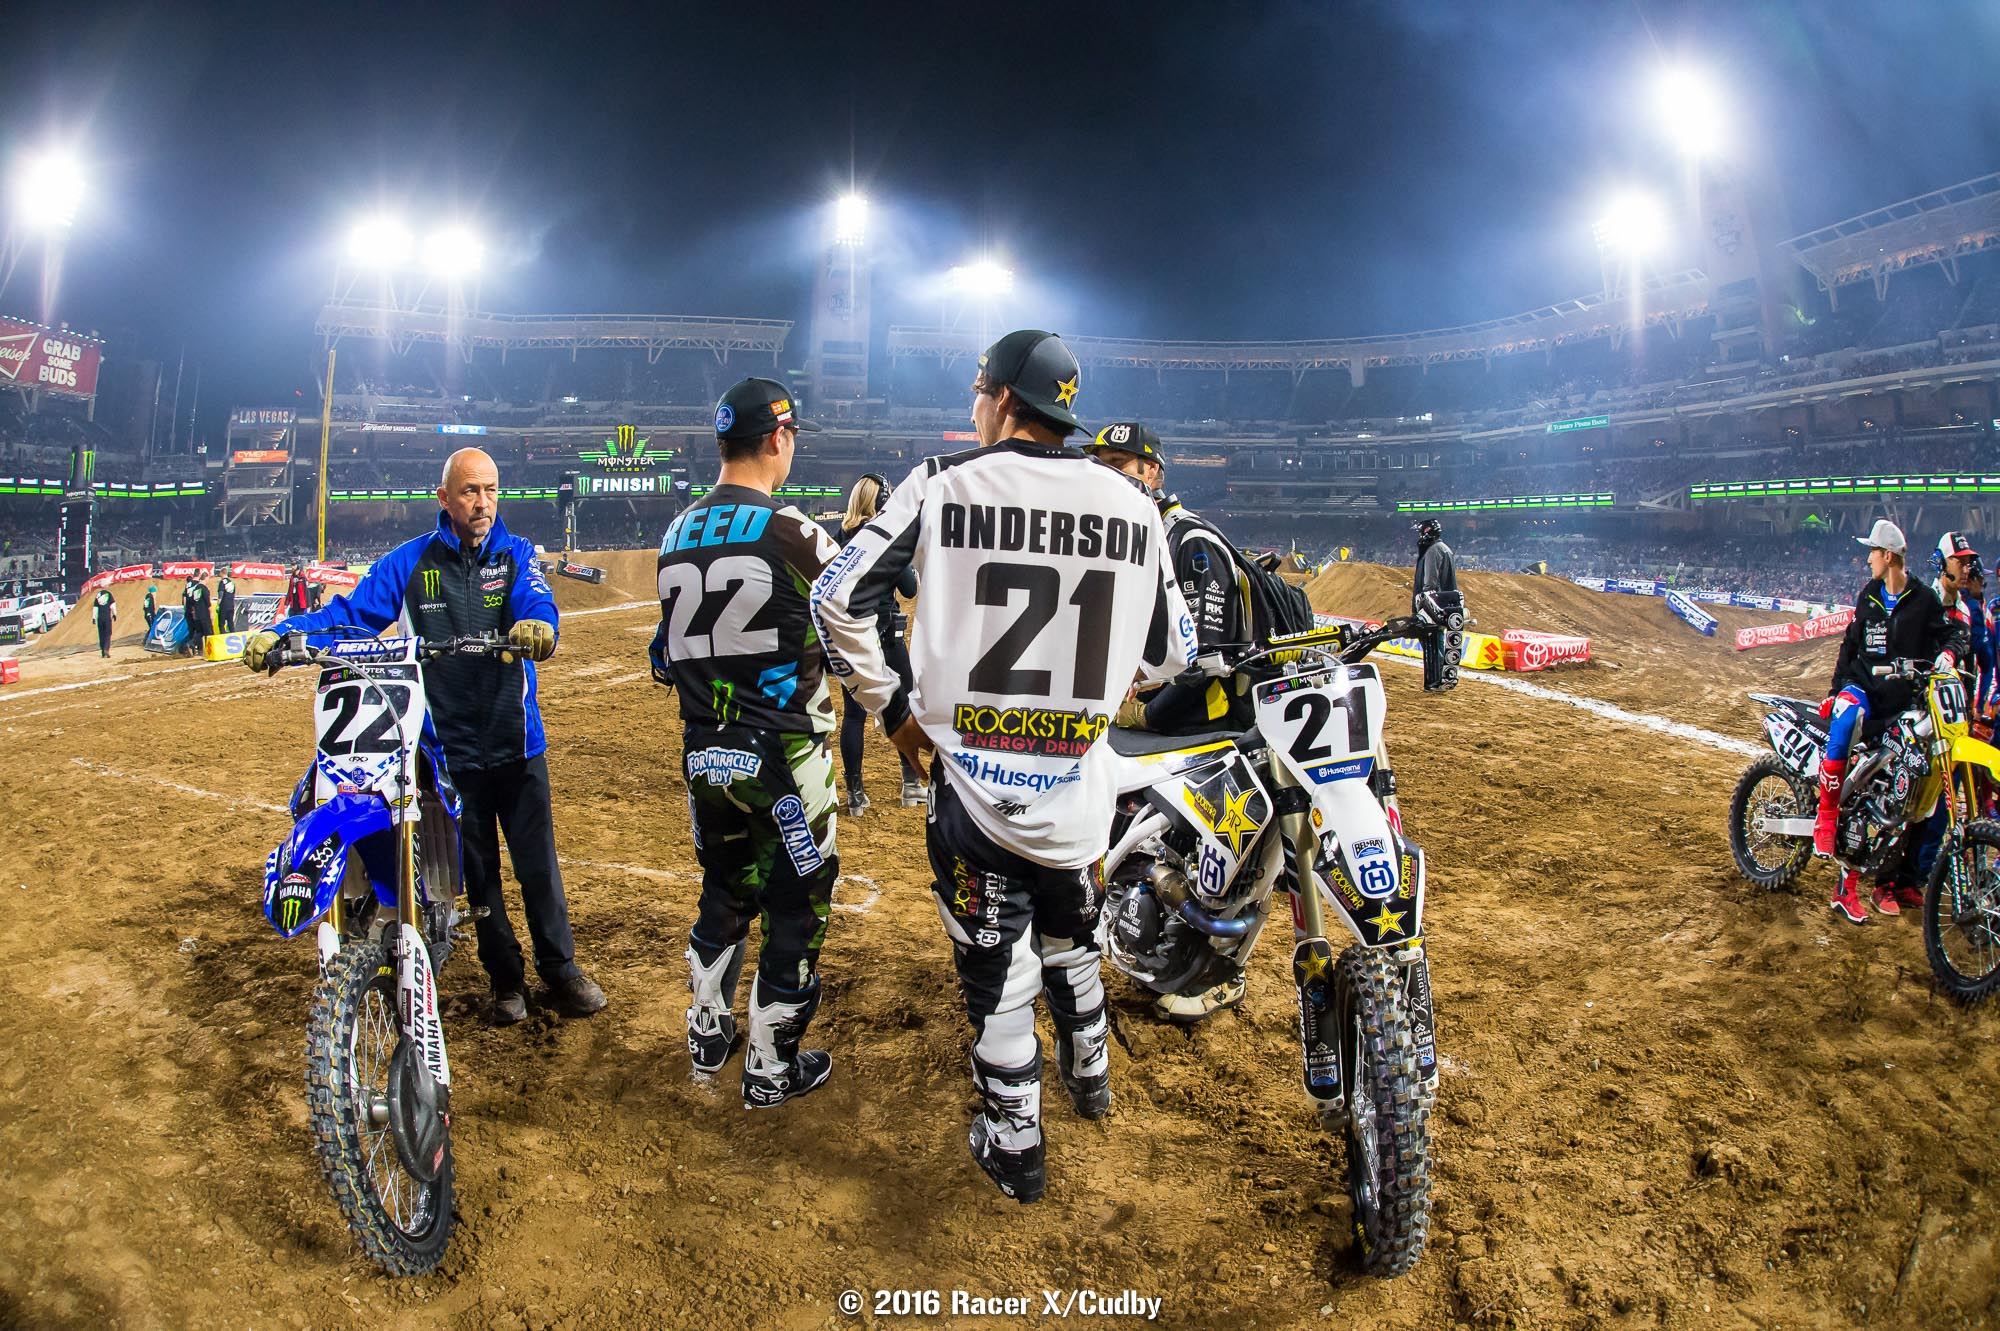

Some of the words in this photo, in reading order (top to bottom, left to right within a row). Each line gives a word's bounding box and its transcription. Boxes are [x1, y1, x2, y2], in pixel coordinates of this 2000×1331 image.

[43, 338, 82, 361] GRAB
[47, 355, 73, 370] SOME
[39, 364, 77, 387] BUDS
[240, 410, 257, 424] LAS
[259, 410, 289, 424] VEGAS
[597, 456, 656, 467] MONSTER
[591, 477, 655, 493] FINISH
[659, 504, 773, 557] REED
[940, 502, 1148, 567] ANDERSON
[244, 567, 283, 577] HONDA
[563, 563, 594, 577] AMSOIL
[847, 549, 868, 573] RACING
[658, 555, 779, 662] 22
[1205, 602, 1223, 615] RK
[1669, 596, 1710, 626] COOPER
[967, 561, 1116, 700] 21
[1757, 626, 1789, 636] TOYOTA
[1820, 613, 1849, 628] TOYOTA
[1550, 642, 1587, 656] TOYOTA
[318, 684, 411, 757] 22
[955, 705, 1110, 742] ROCKSTAR
[1284, 685, 1370, 764] 21
[964, 732, 1038, 752] ENERGY
[1046, 740, 1093, 756] DRIN
[1779, 728, 1817, 775] 94
[688, 754, 708, 774] FOR
[708, 751, 757, 774] MIRACLE
[1327, 763, 1361, 776] Husqvarna
[709, 767, 730, 784] BOY
[280, 885, 312, 900] YAMAHA
[414, 946, 425, 1061] DUNLOP
[427, 1018, 442, 1080] AMAHA
[1309, 1054, 1337, 1065] GALFER
